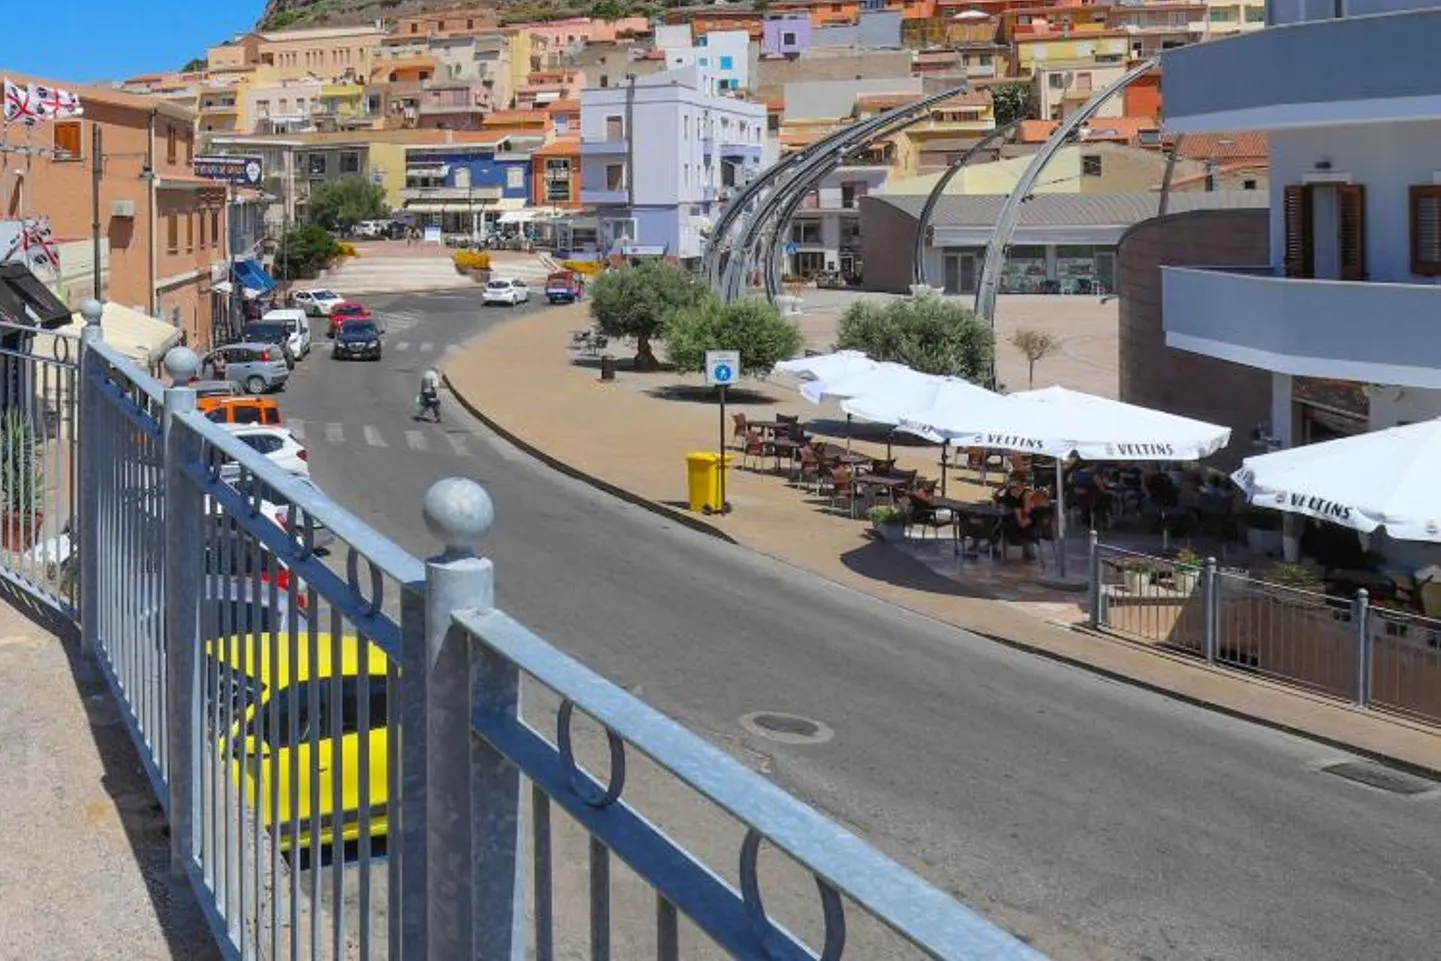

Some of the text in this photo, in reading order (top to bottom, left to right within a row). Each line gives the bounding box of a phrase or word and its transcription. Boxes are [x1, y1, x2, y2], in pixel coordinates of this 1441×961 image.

[987, 433, 1044, 449] VELTINS
[1117, 443, 1174, 456] VELTINS
[1290, 492, 1354, 520] VELTINS
